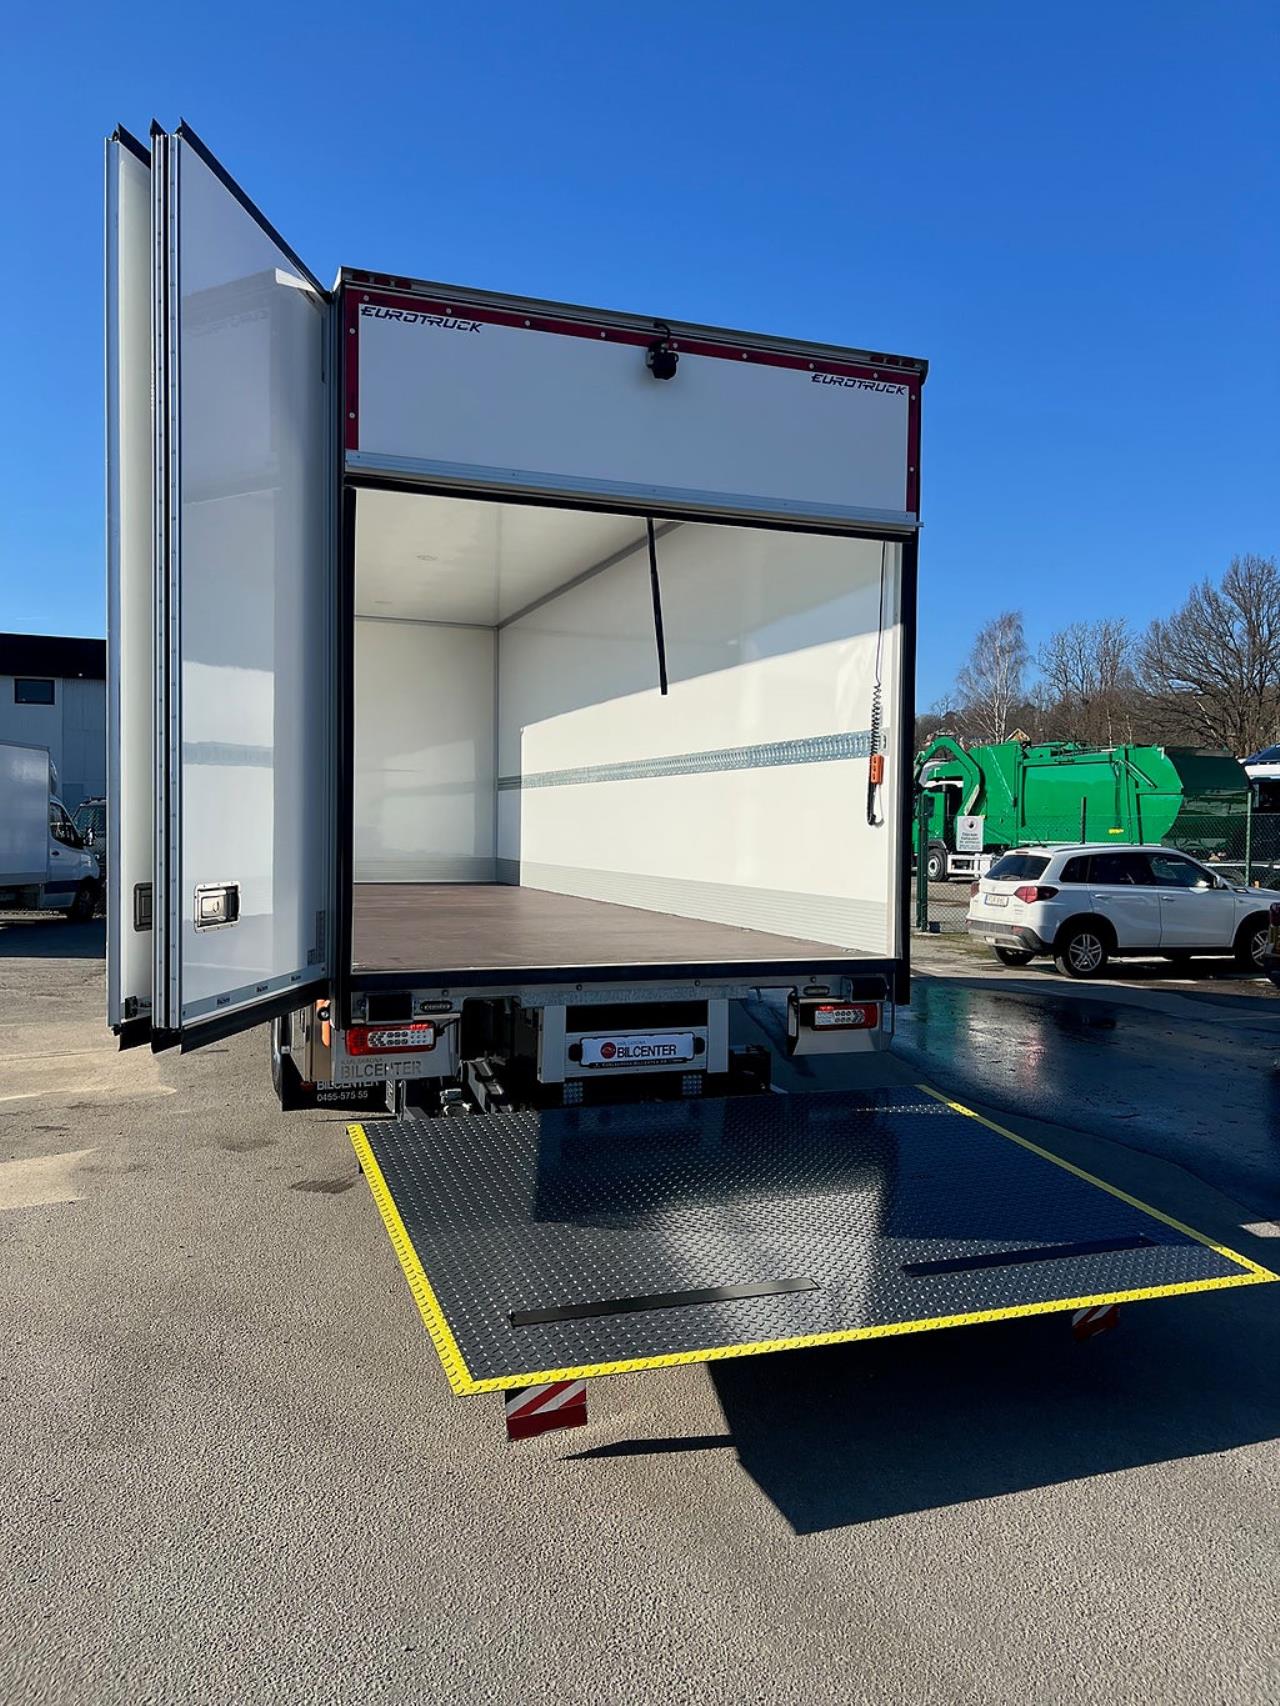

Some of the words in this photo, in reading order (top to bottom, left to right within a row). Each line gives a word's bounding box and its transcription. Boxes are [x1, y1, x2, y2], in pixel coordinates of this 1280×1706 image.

[361, 305, 482, 333] EUROTRUCK
[811, 373, 907, 396] EUROTRUCK
[616, 1044, 677, 1058] BILCENTER
